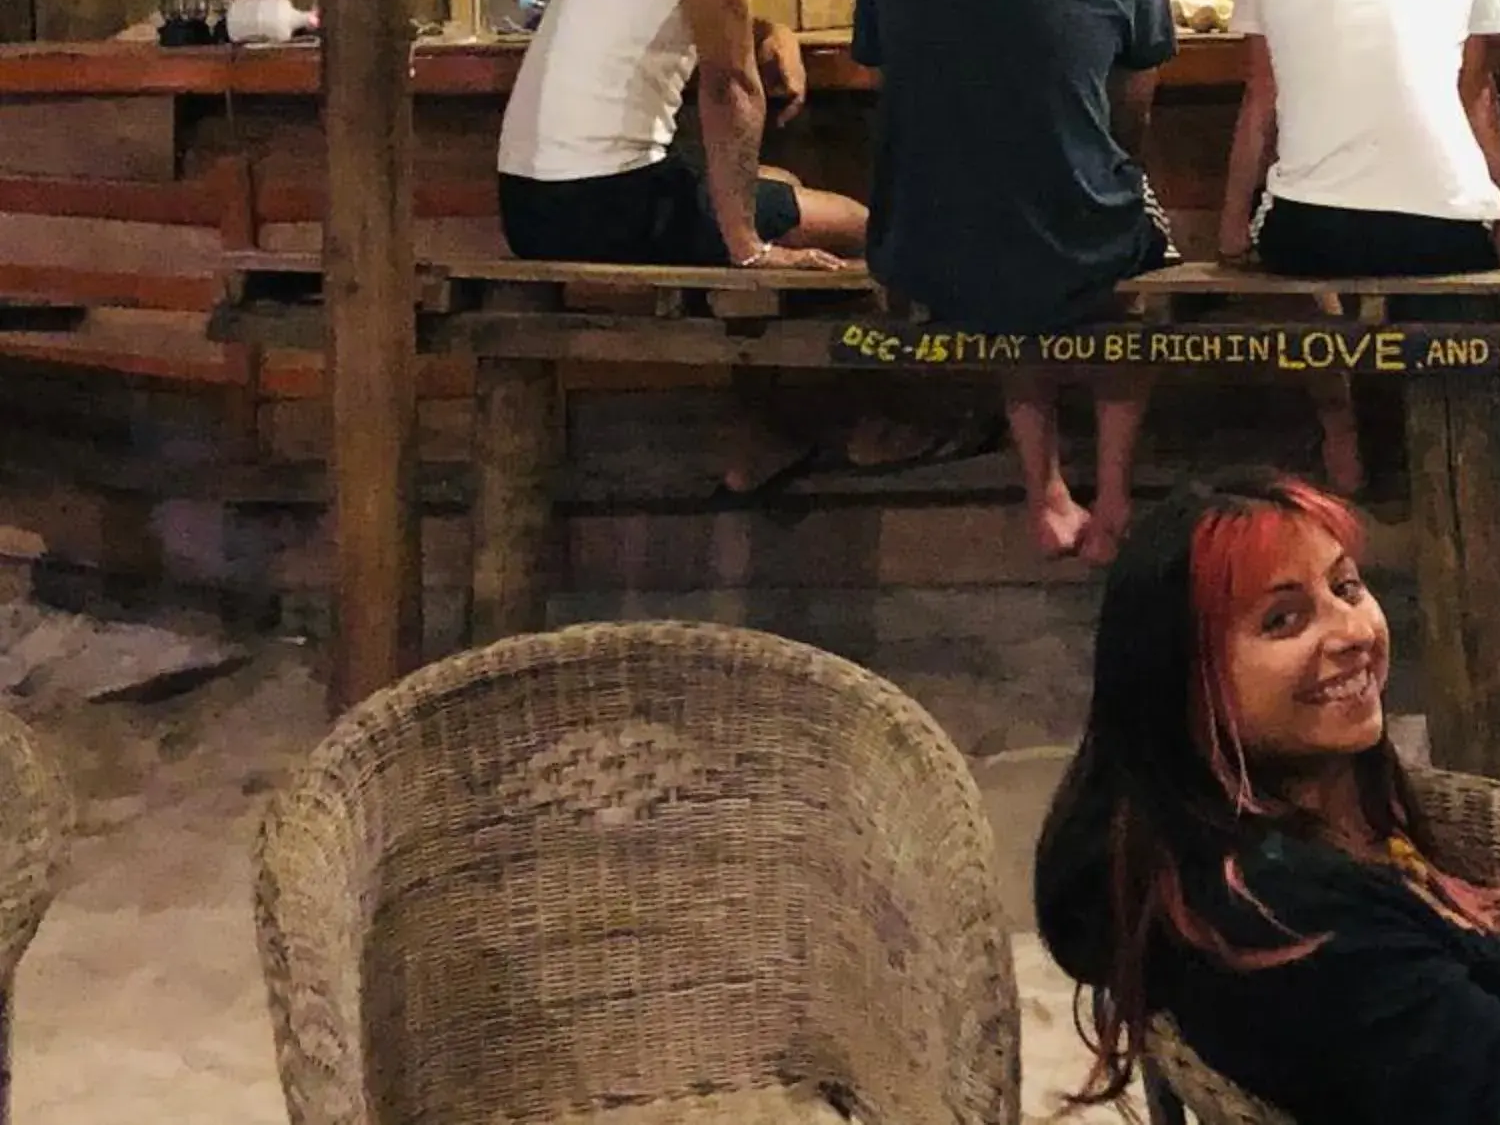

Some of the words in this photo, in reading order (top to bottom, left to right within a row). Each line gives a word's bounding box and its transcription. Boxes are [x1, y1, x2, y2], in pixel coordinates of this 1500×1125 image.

[955, 332, 1026, 362] MAY
[1038, 333, 1096, 361] YOU
[1104, 333, 1144, 362] BE
[1150, 333, 1222, 363] RICH
[1225, 333, 1272, 363] IN
[1427, 338, 1490, 366] AND
